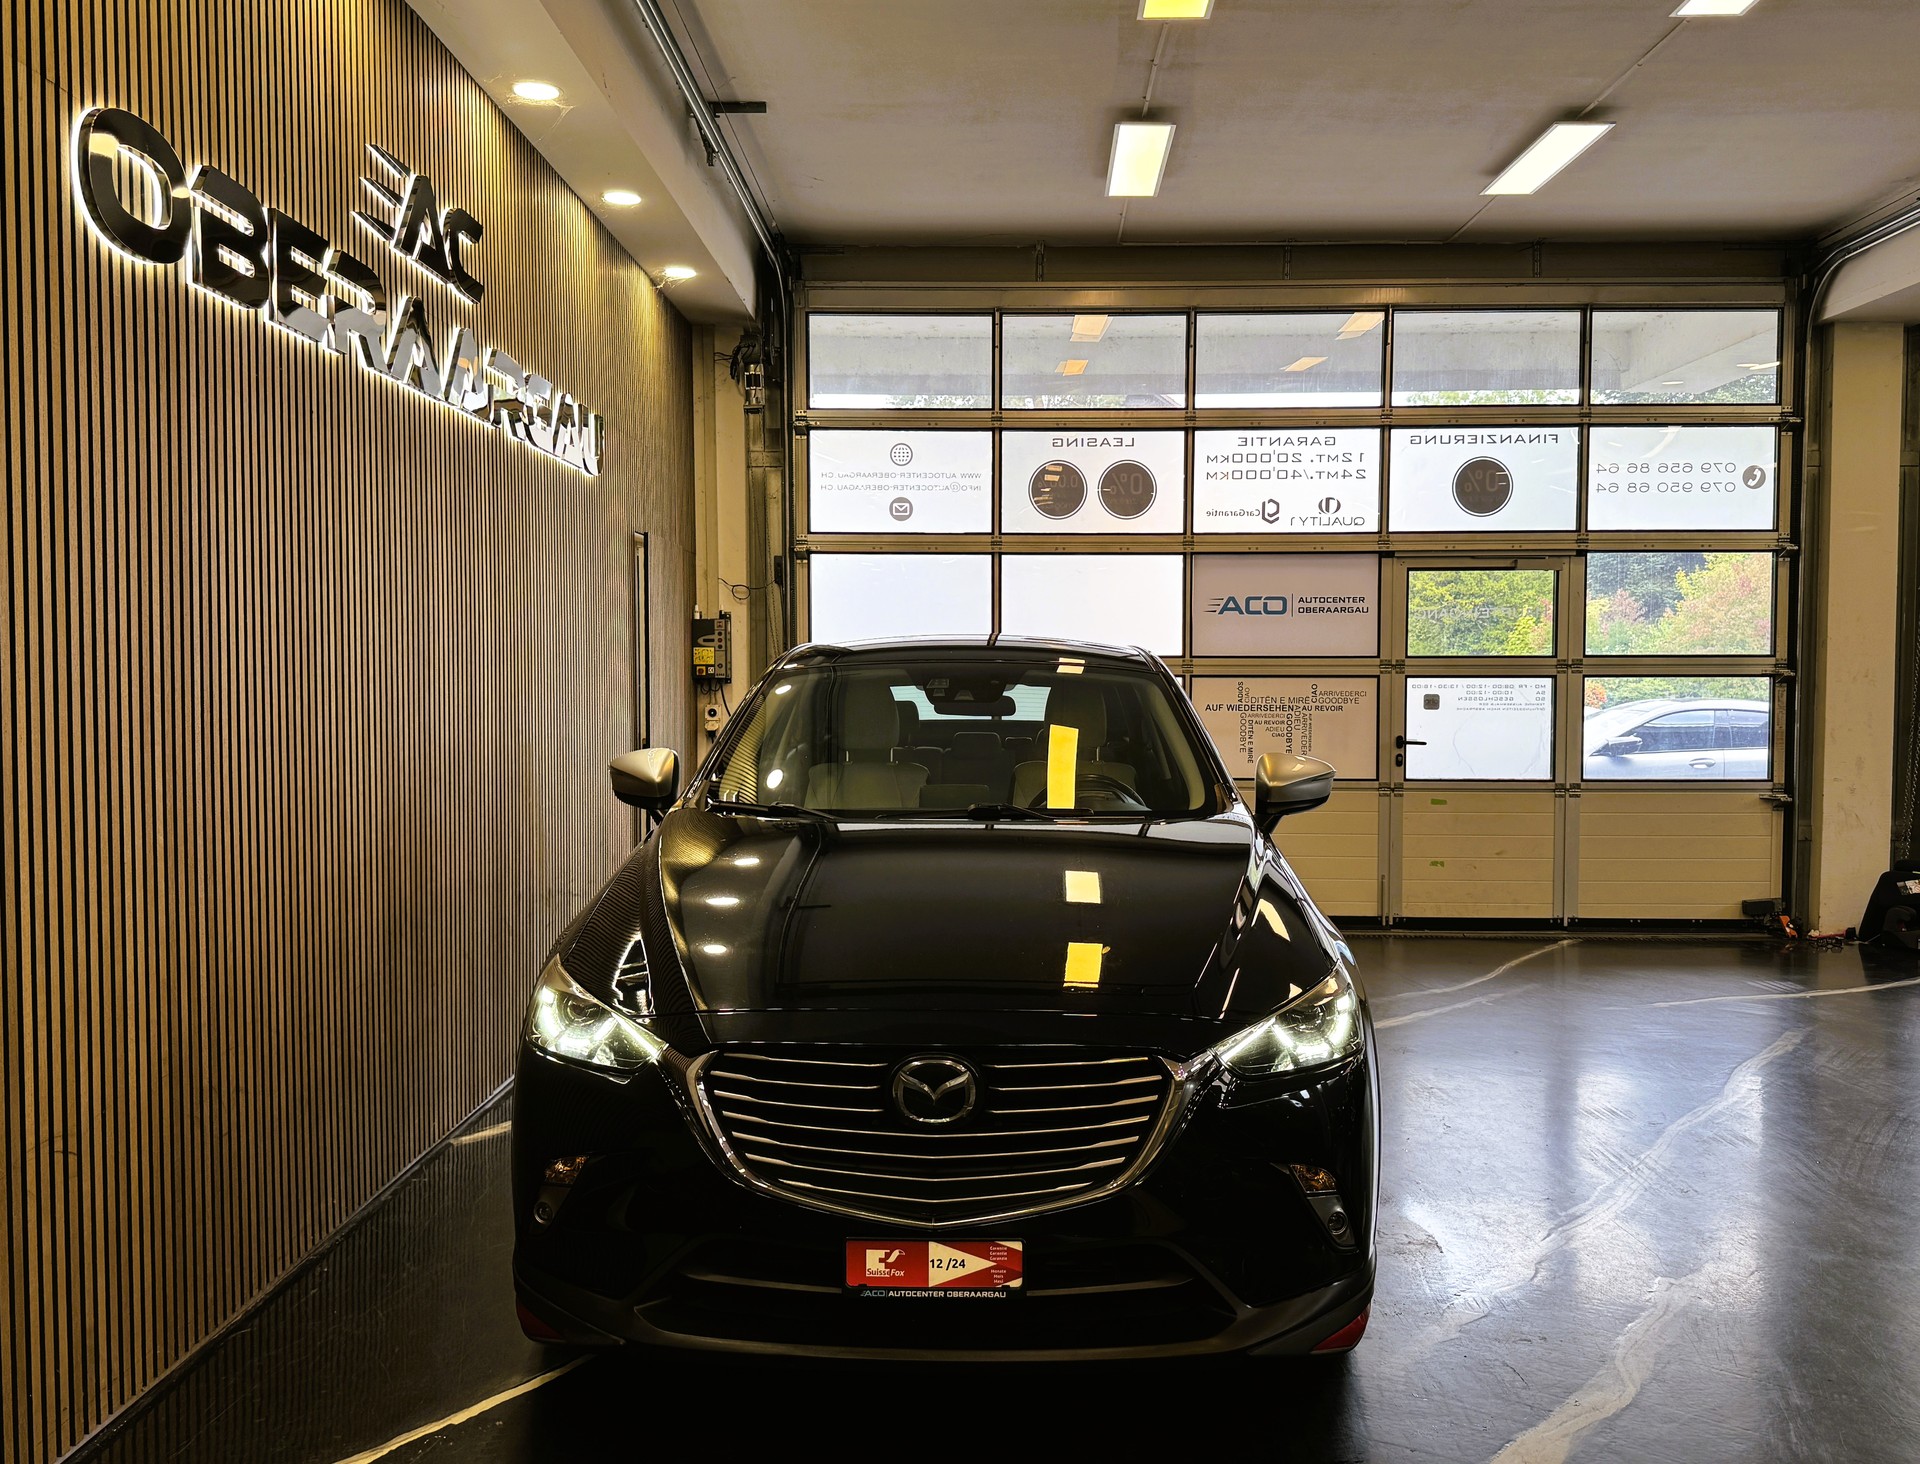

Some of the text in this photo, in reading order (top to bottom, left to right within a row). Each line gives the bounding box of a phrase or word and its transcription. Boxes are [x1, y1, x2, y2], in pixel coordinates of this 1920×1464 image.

[72, 106, 604, 478] OBERAARGAU
[1218, 596, 1287, 615] ACO
[930, 1259, 943, 1268] 12
